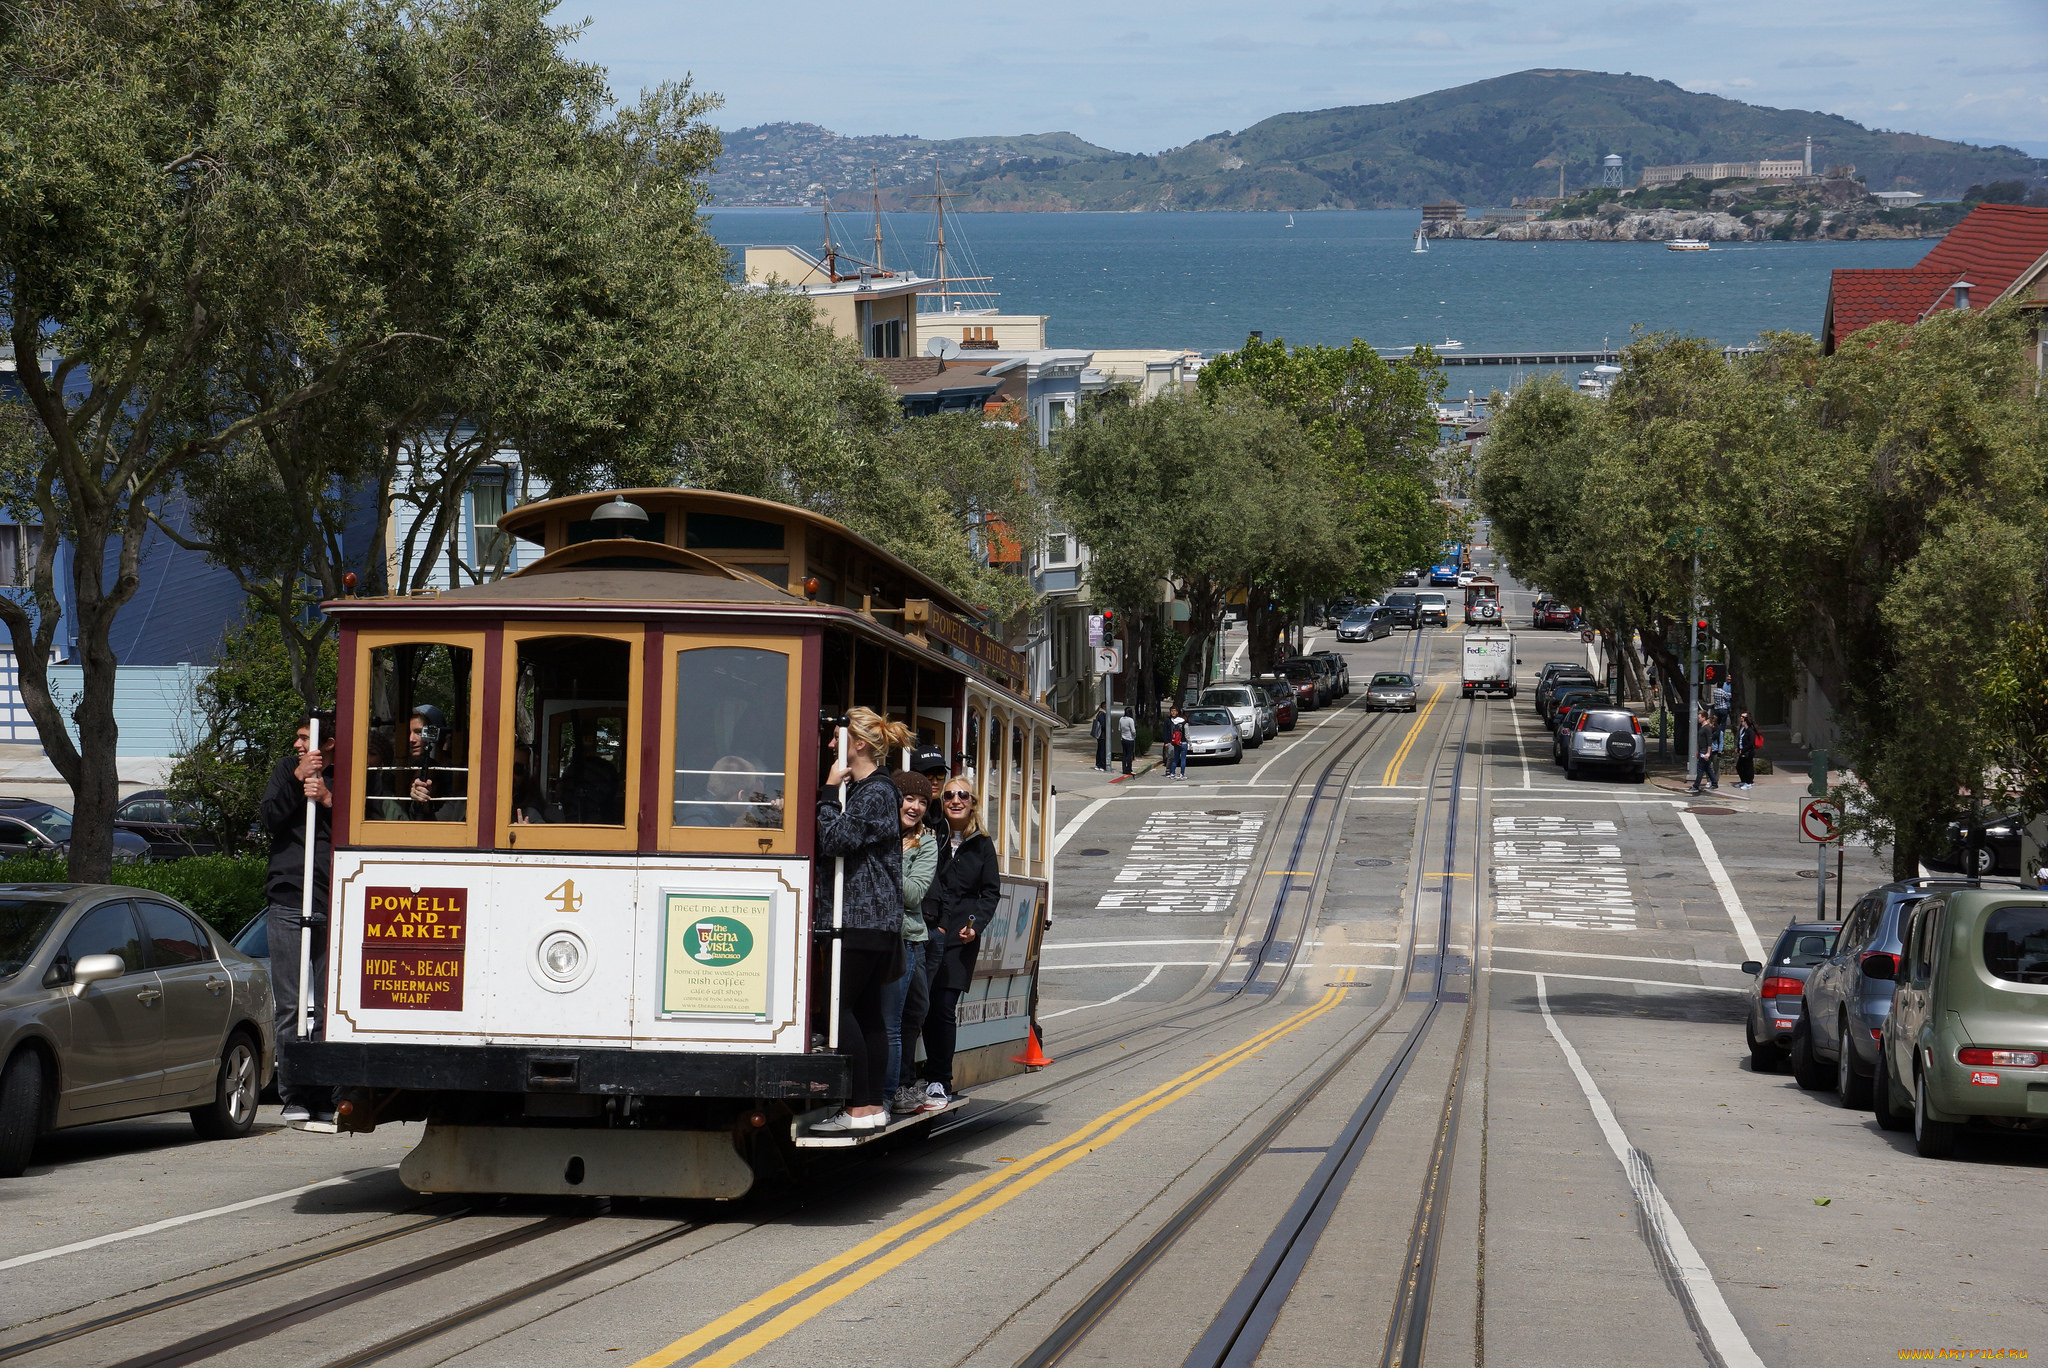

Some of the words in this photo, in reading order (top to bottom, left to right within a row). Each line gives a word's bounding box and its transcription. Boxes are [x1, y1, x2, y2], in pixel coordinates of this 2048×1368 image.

[931, 609, 970, 648] POWELL
[975, 635, 981, 653] &
[986, 641, 1007, 668] HYDE
[544, 878, 583, 912] 4
[370, 896, 460, 911] POWELL
[393, 912, 438, 923] AND
[367, 924, 461, 938] MARKET
[713, 924, 728, 932] the
[365, 959, 397, 975] HYDE
[401, 961, 415, 976] AND
[418, 961, 458, 977] BEACH
[373, 980, 450, 992] FISHERMANS
[391, 993, 431, 1004] WHARF
